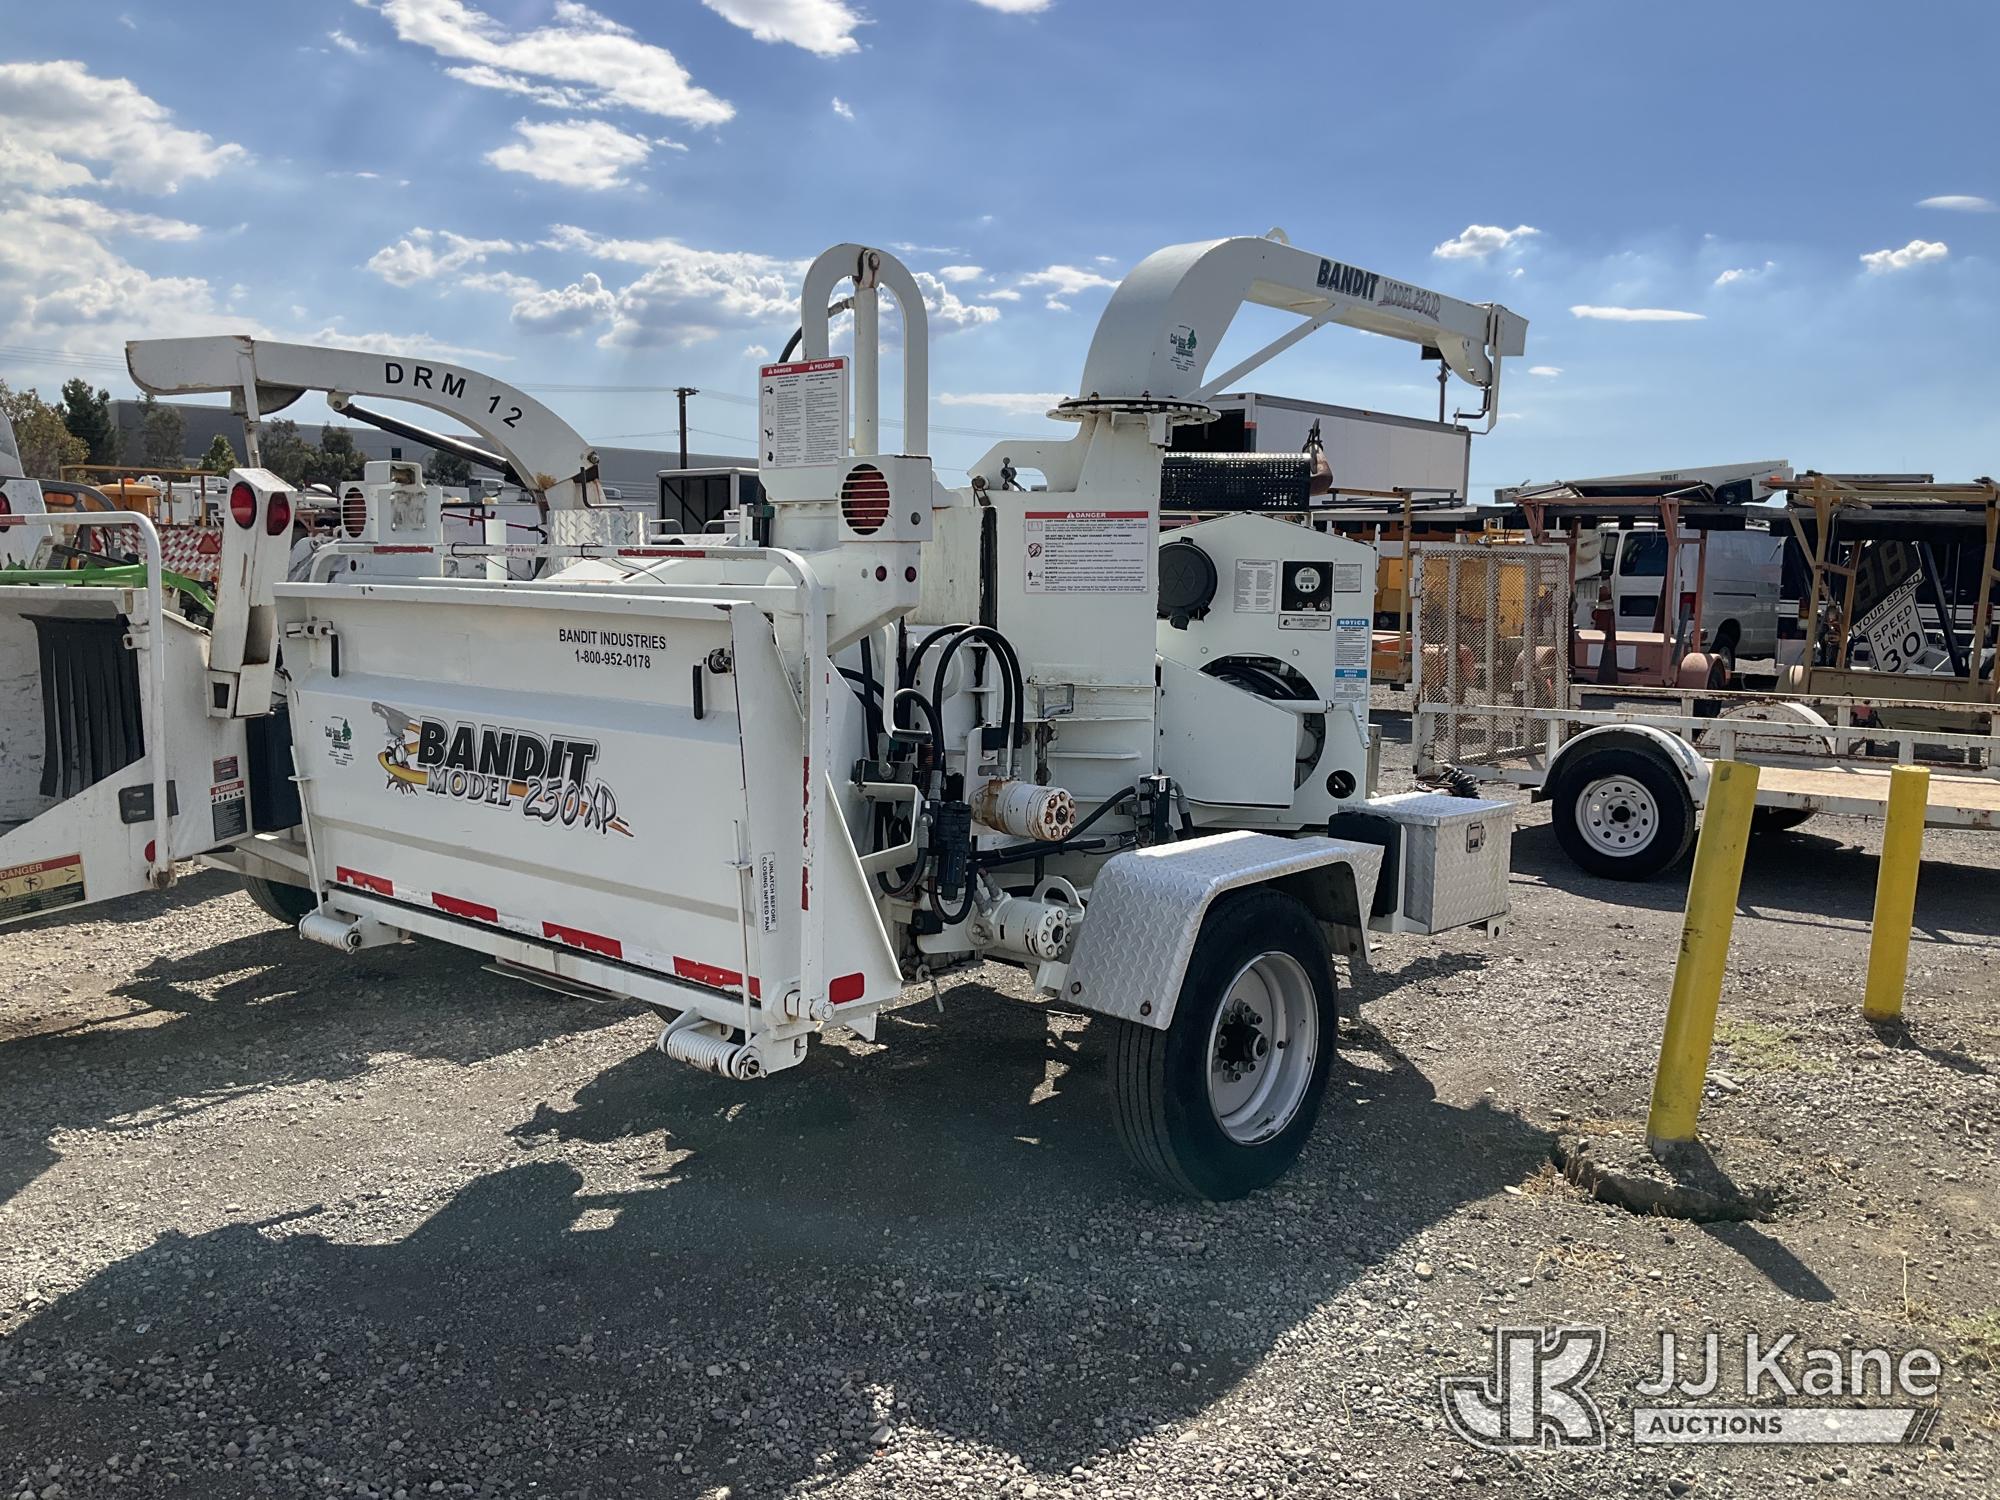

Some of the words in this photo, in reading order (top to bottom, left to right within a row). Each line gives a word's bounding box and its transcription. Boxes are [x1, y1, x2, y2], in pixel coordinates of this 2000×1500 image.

[1316, 258, 1379, 301] BANDIT
[773, 367, 792, 375] DANGER
[814, 362, 835, 370] PELIGRO
[385, 362, 467, 399] DRM
[488, 395, 523, 429] 12
[1855, 603, 1885, 631] YOUR
[1886, 573, 1920, 606] SPEED
[559, 629, 597, 645] BANDIT
[600, 631, 666, 650] INDUSTRIES
[1873, 605, 1912, 642] SPEED
[1880, 620, 1912, 652] LIMIT
[575, 649, 651, 669] 1-800-952-0178
[1882, 632, 1921, 673] 30
[417, 719, 596, 790] BANDIT
[220, 782, 238, 793] DANGER
[426, 766, 512, 807] MODEL
[0, 863, 43, 880] DANGER
